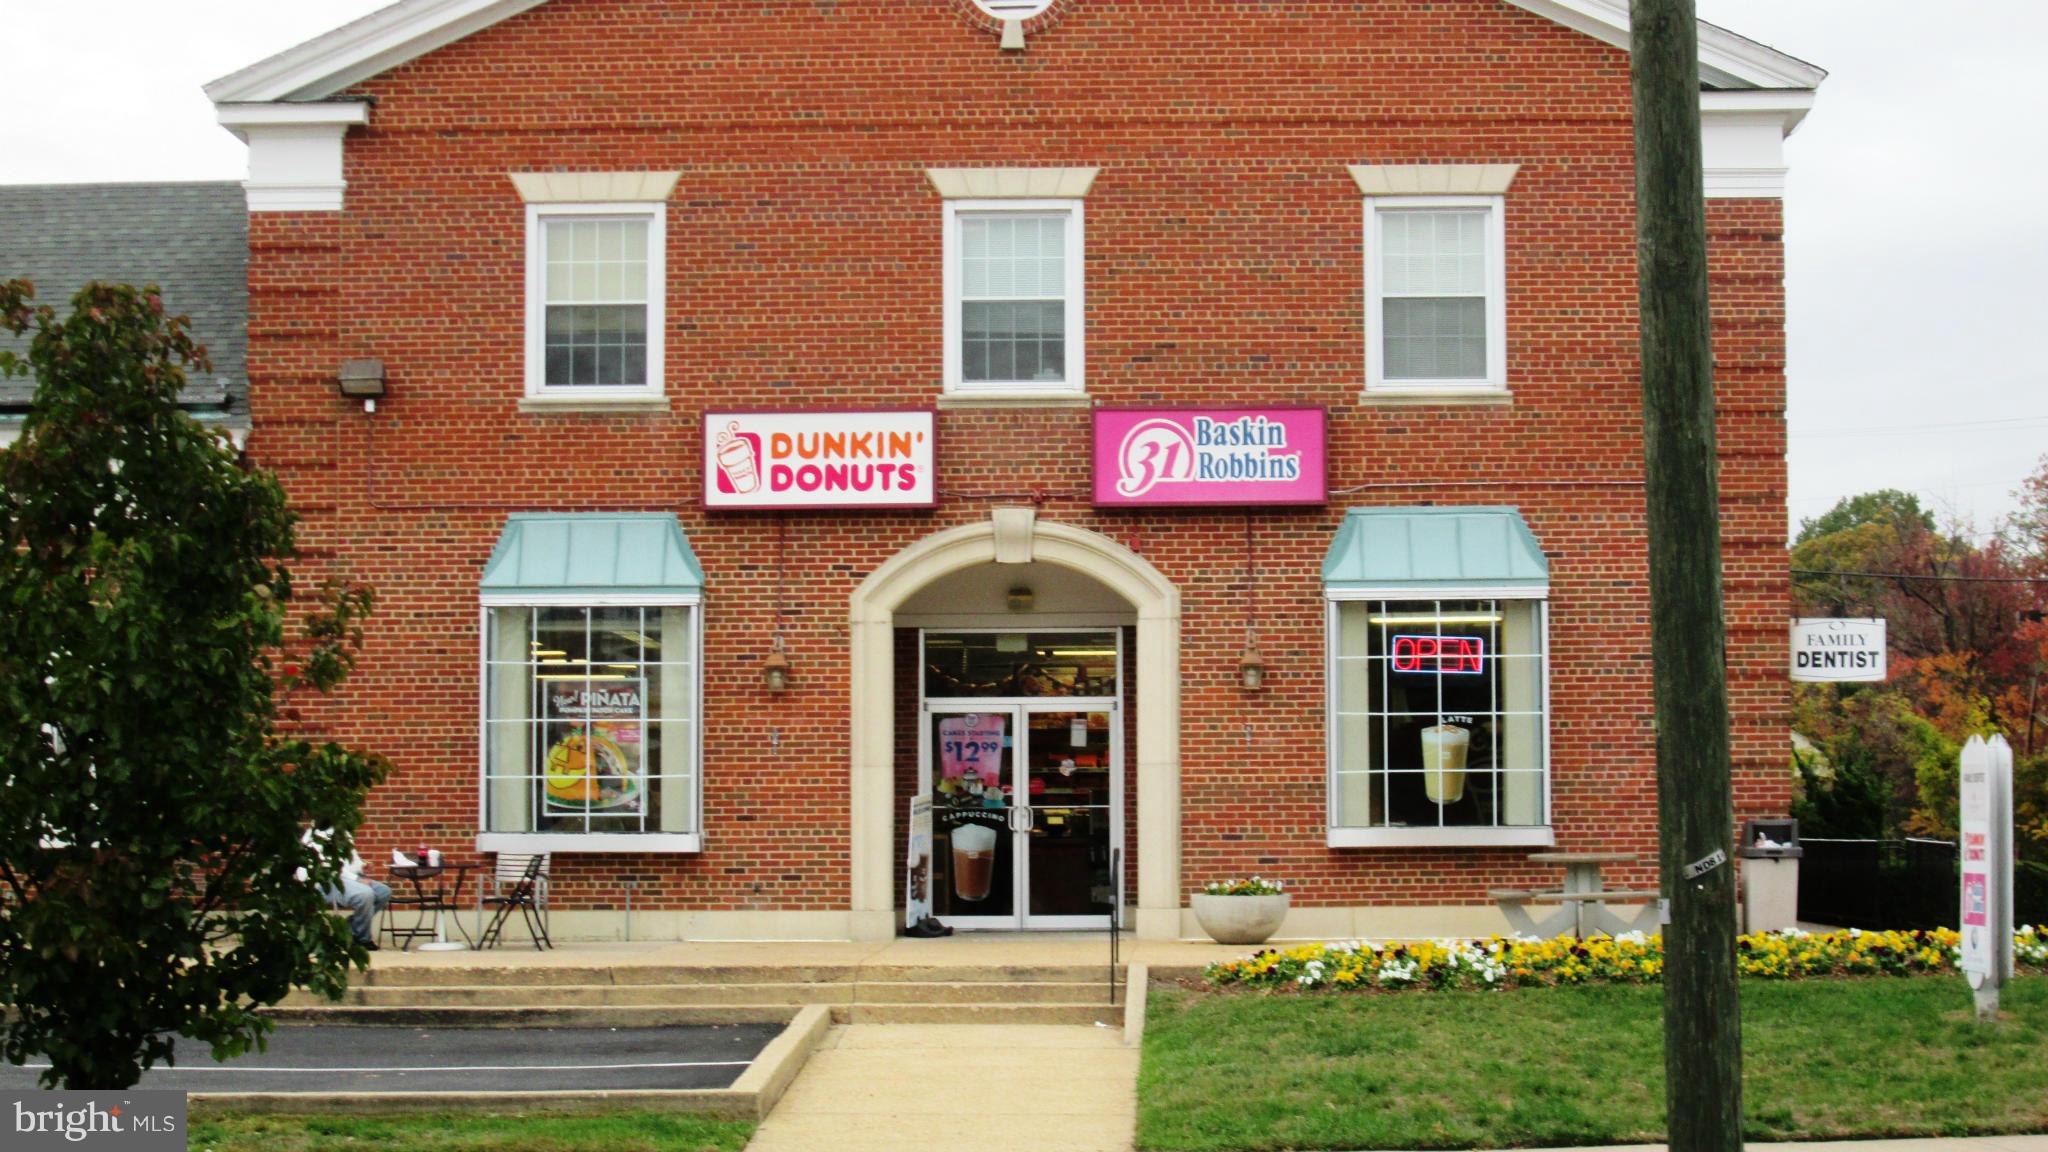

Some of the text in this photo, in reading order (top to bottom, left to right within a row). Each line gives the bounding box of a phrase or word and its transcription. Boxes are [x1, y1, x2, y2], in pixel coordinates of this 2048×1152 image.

[771, 431, 923, 459] DUNKIN'
[1196, 418, 1284, 446] Baskin
[771, 463, 916, 492] DONUTS
[1119, 441, 1182, 492] 31
[1199, 451, 1297, 479] Robbins
[1807, 633, 1867, 646] FAMILY
[1395, 638, 1481, 671] OPEN
[1797, 651, 1879, 668] DENTIST
[581, 689, 641, 706] PIÑATA
[942, 811, 1005, 822] CAPPUCCINO
